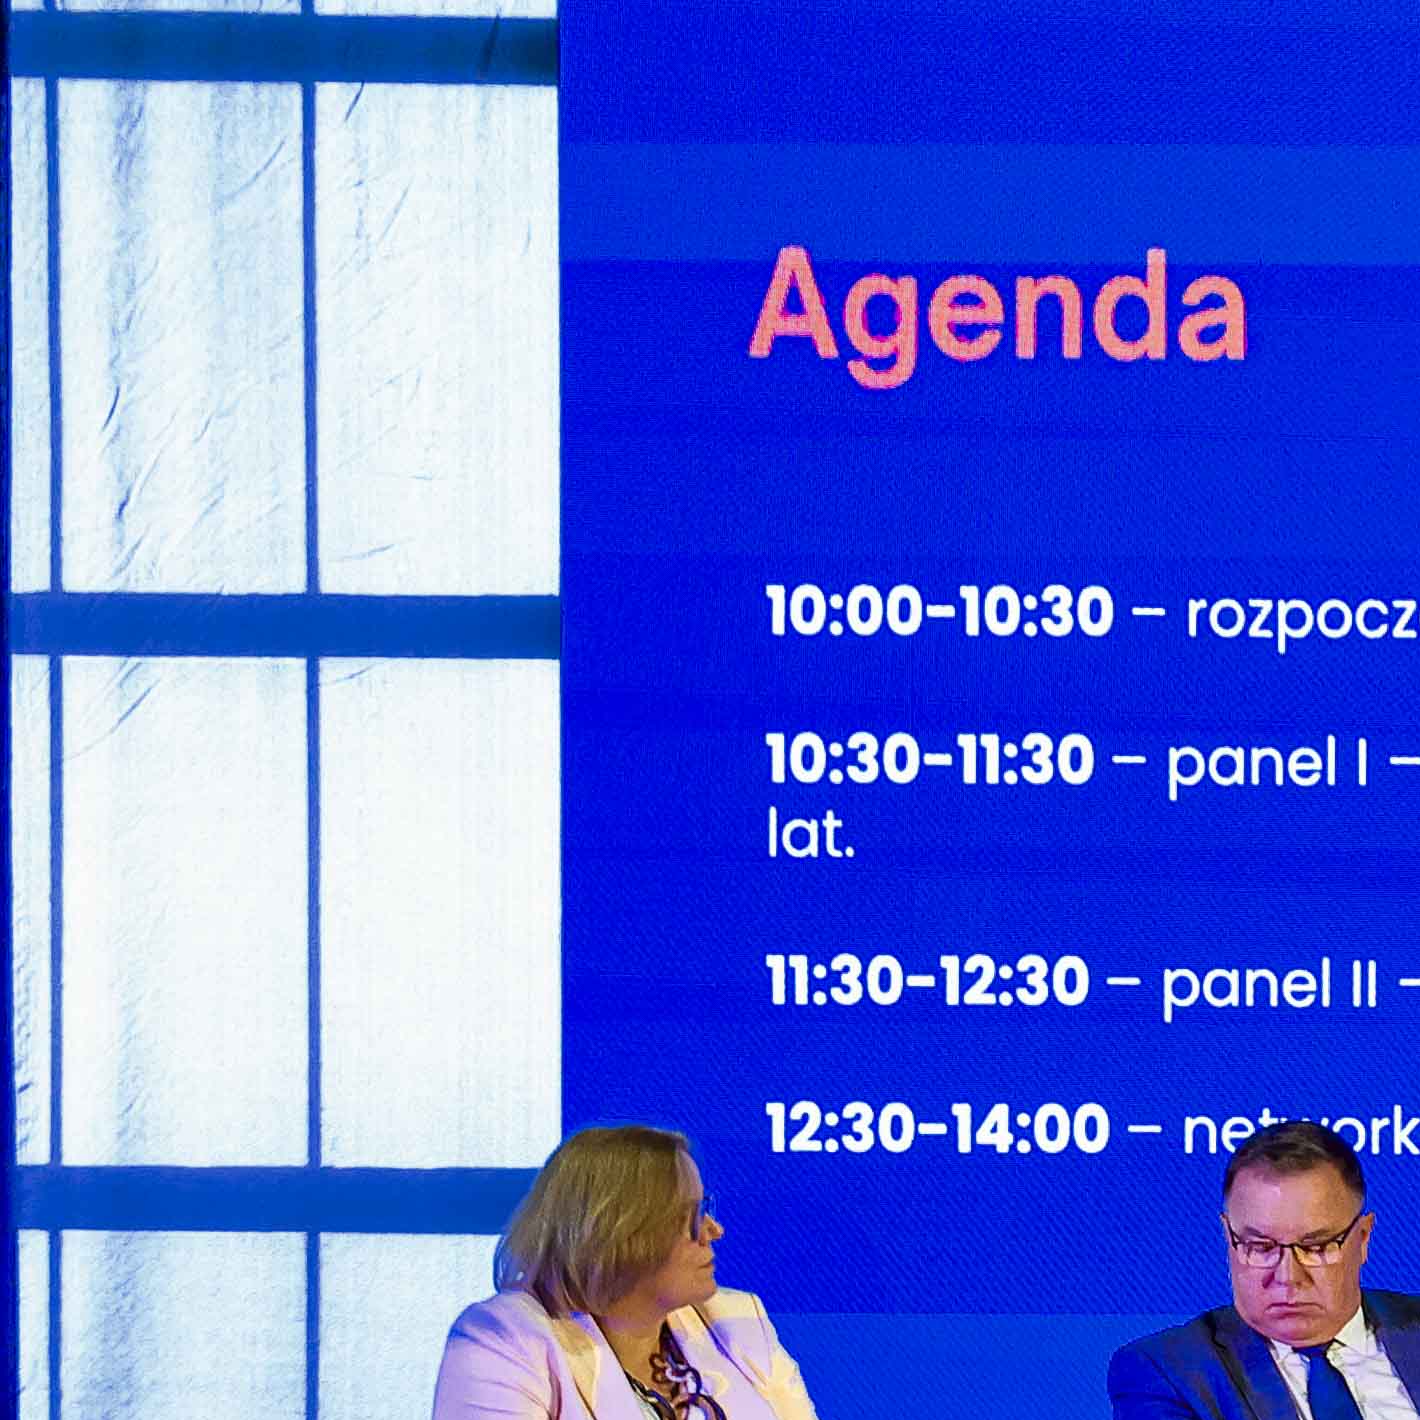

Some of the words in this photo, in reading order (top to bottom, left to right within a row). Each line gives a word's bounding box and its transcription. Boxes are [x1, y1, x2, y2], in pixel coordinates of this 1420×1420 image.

[749, 245, 1246, 389] Agenda
[1169, 734, 1336, 801] panel
[1357, 738, 1368, 786] I
[769, 806, 854, 858] lat.
[1163, 957, 1331, 1023] panel
[1352, 959, 1377, 1008] II
